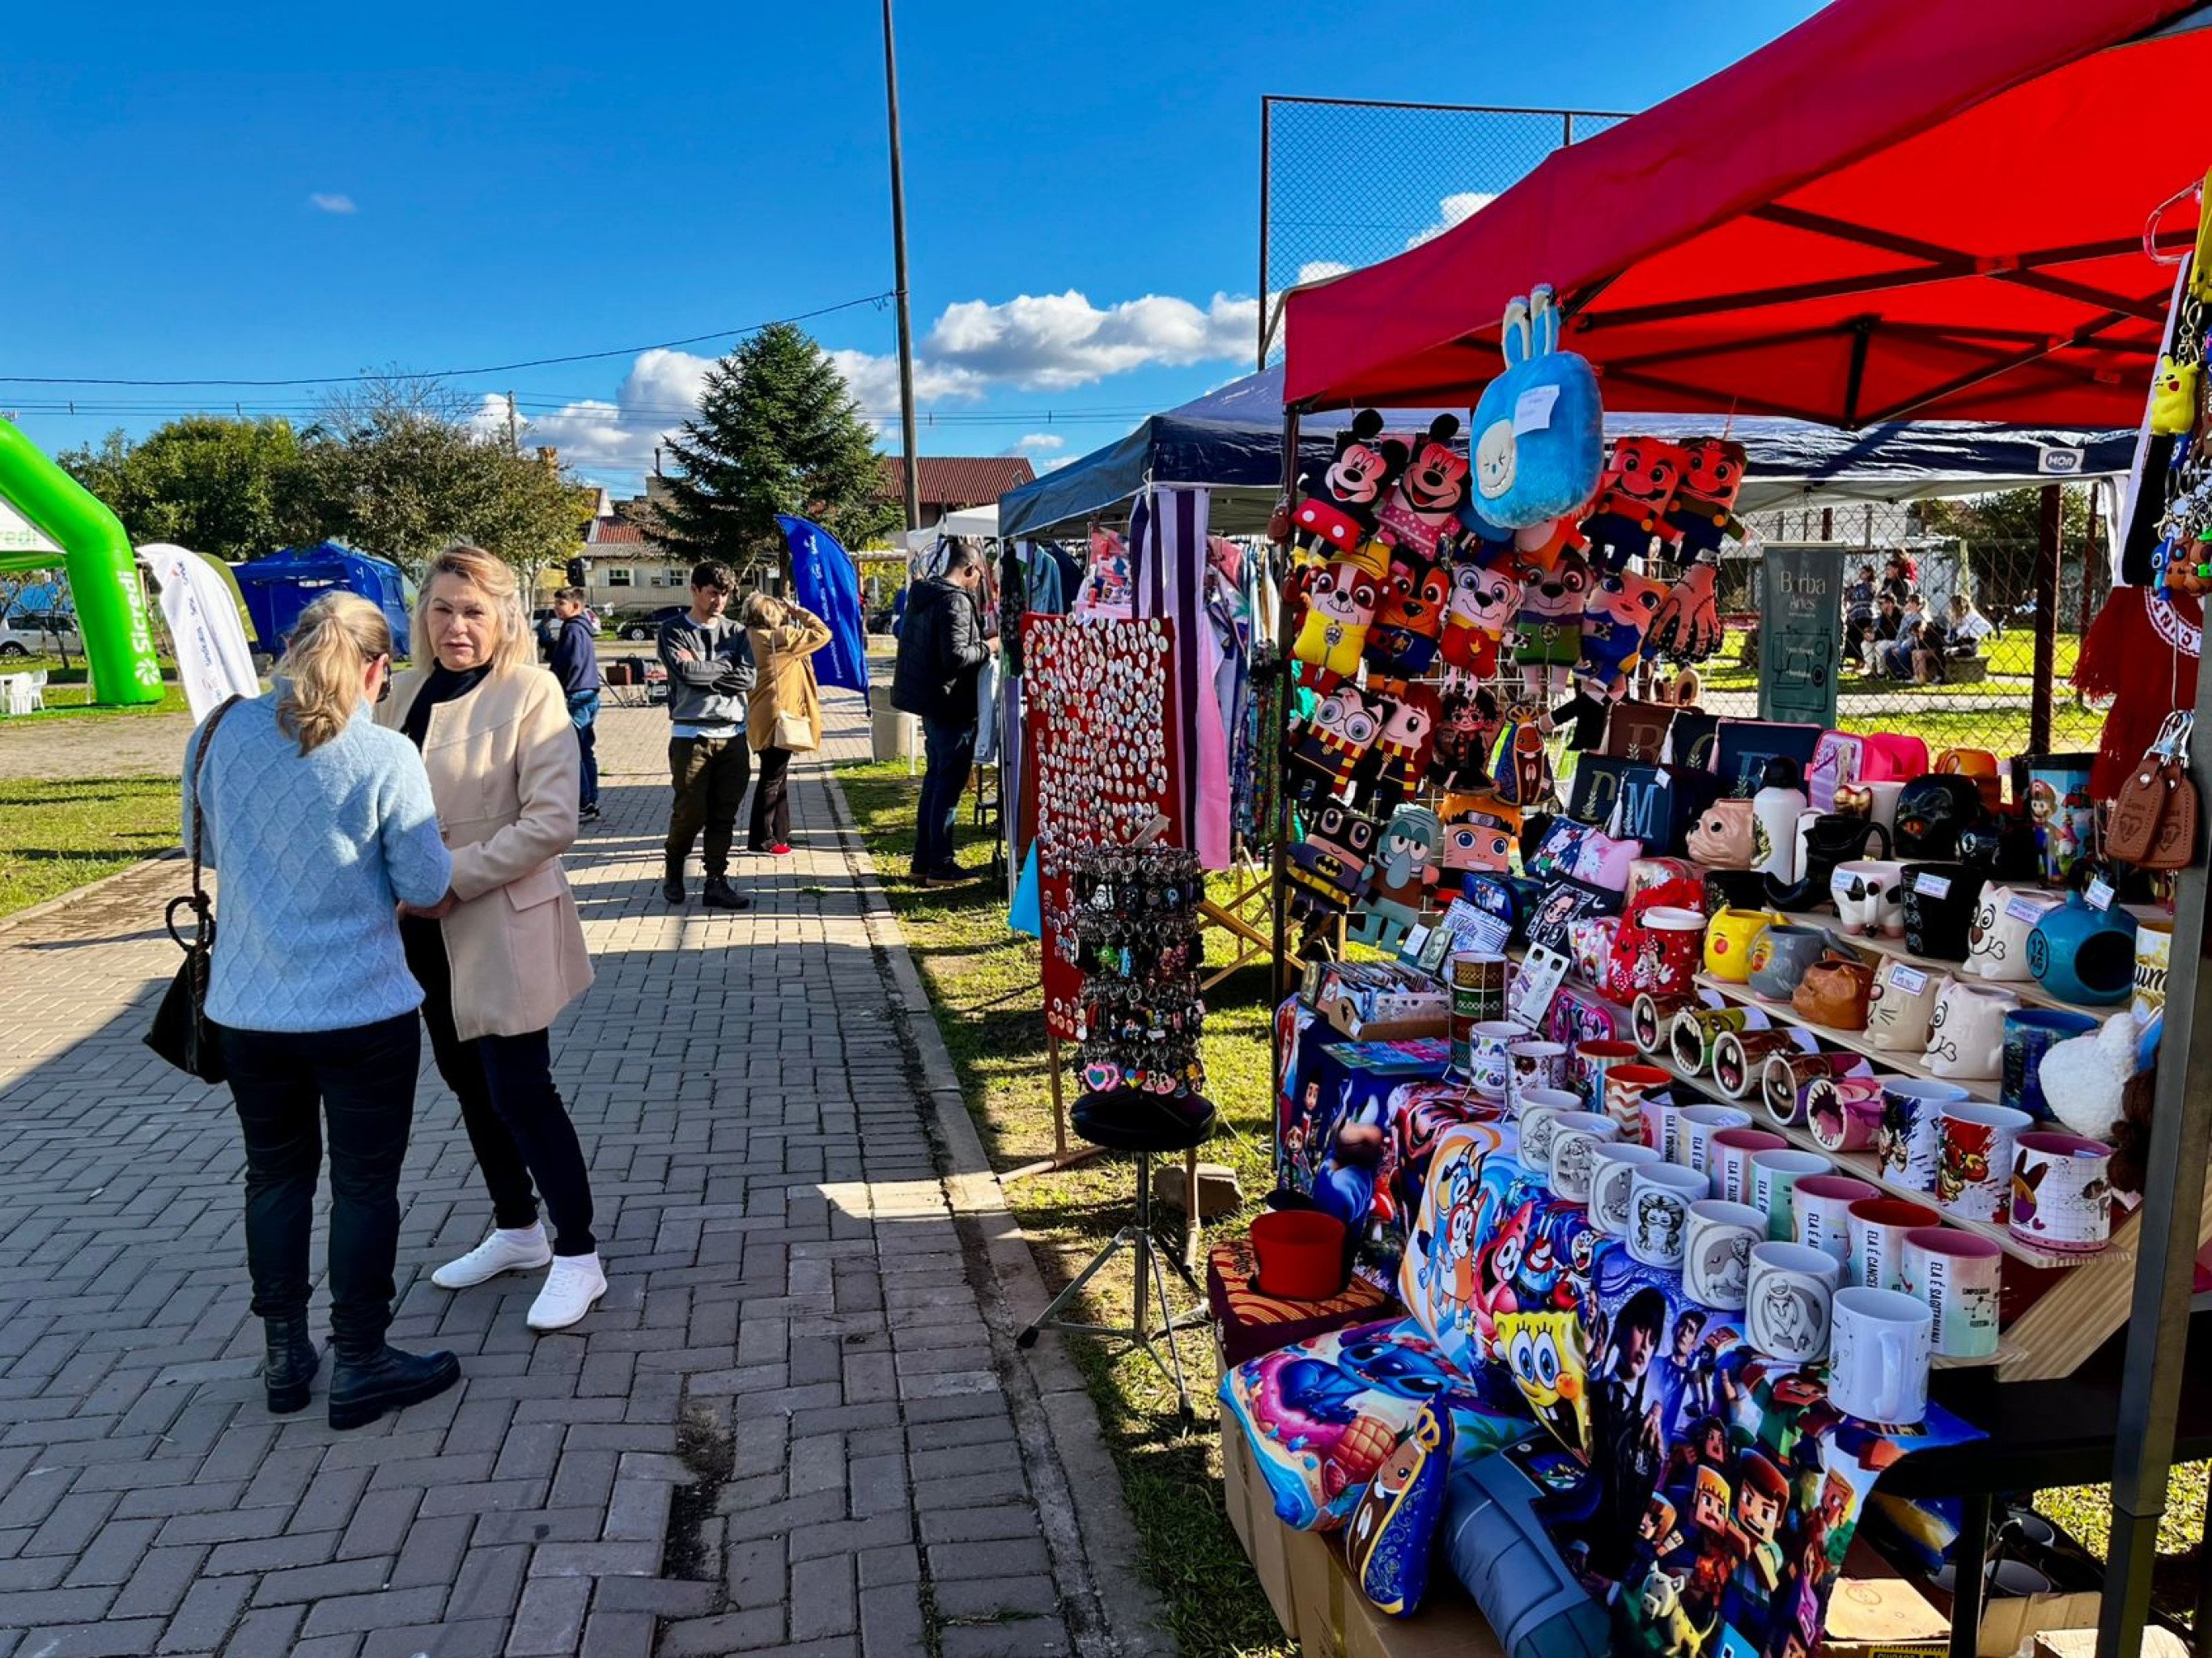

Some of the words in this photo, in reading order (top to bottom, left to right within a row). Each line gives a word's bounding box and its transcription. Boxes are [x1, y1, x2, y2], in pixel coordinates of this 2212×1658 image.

[1780, 570, 1826, 595] Brba
[117, 570, 151, 653] Sicredi
[1624, 782, 1660, 838] M
[2031, 939, 2044, 956] 12
[1692, 1136, 1702, 1150] ELA
[1728, 1160, 1738, 1174] ELA
[1759, 1180, 1767, 1195] ELA
[1808, 1212, 1819, 1228] ELA
[1808, 1230, 1821, 1238] É
[1867, 1230, 1879, 1245] ELA
[1867, 1248, 1881, 1256] É
[1930, 1261, 1942, 1277] ELA
[1930, 1280, 1945, 1288] É
